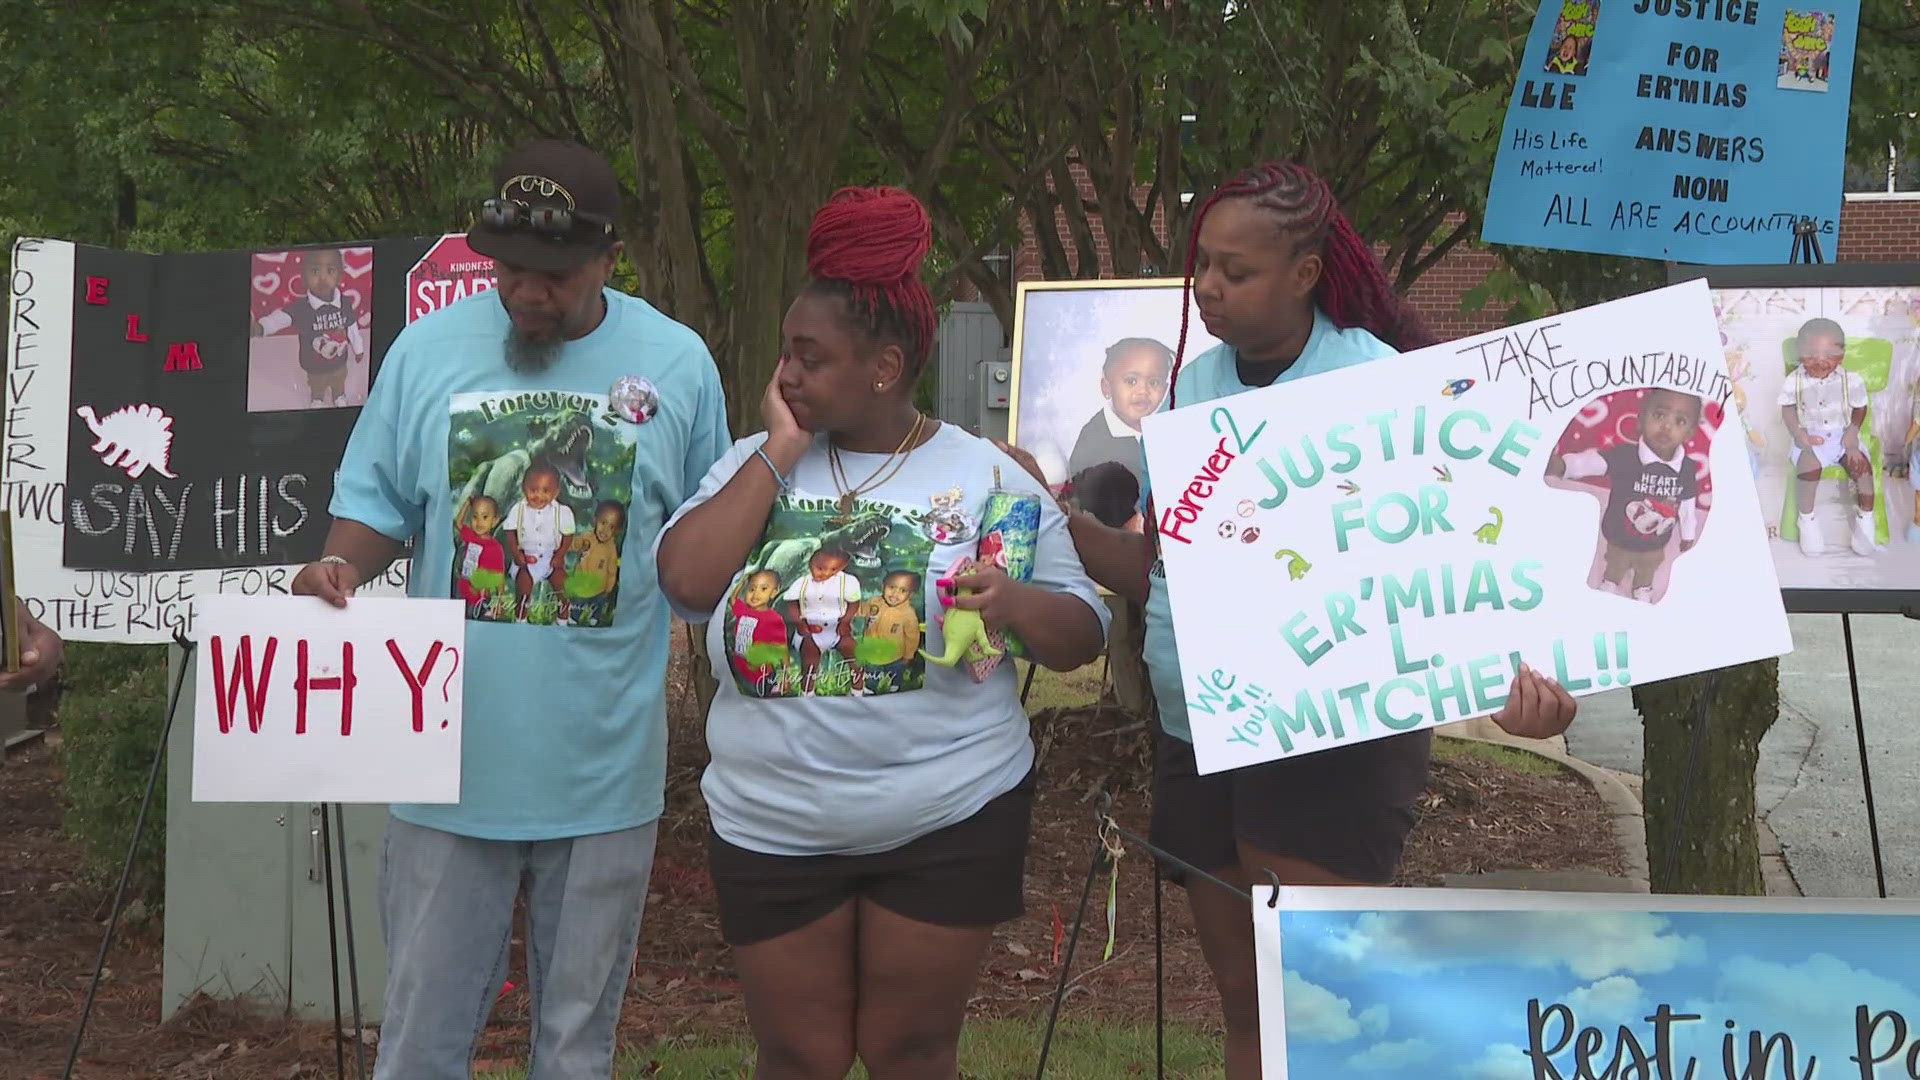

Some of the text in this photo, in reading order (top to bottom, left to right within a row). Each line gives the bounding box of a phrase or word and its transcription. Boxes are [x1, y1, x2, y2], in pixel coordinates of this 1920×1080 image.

[1634, 0, 1759, 25] JUSTICE
[1667, 42, 1719, 73] FOR
[1637, 74, 1747, 108] ER'MIAS
[1513, 128, 1588, 150] His Life
[1635, 126, 1764, 163] ANSWERS
[1521, 158, 1603, 180] Mattered!
[1673, 175, 1729, 202] NOW
[1544, 193, 1592, 227] ALL
[1610, 201, 1661, 230] ARE
[450, 260, 494, 272] KINDNESS
[415, 277, 498, 317] STA
[316, 311, 342, 323] HEART
[1456, 323, 1577, 382] TAKE
[1529, 352, 1733, 420] ACCOUNTABILITY
[480, 391, 599, 424] Forever
[1159, 407, 1267, 544] Forever 2
[1256, 405, 1543, 509] JUSTICE
[1641, 473, 1678, 486] HEART
[3, 481, 65, 526] TWO
[71, 473, 309, 560] SAY HIS
[778, 494, 902, 518] Forever
[1331, 482, 1455, 552] FOR
[74, 567, 289, 609] JUSTICE FOR
[48, 598, 116, 631] THE
[1280, 559, 1544, 667] ER'MIAS
[1389, 622, 1445, 675] L.
[211, 635, 459, 736] WHY?
[756, 664, 803, 697] Justice
[1187, 669, 1235, 714] We
[1523, 999, 1920, 1080] Rest in P
